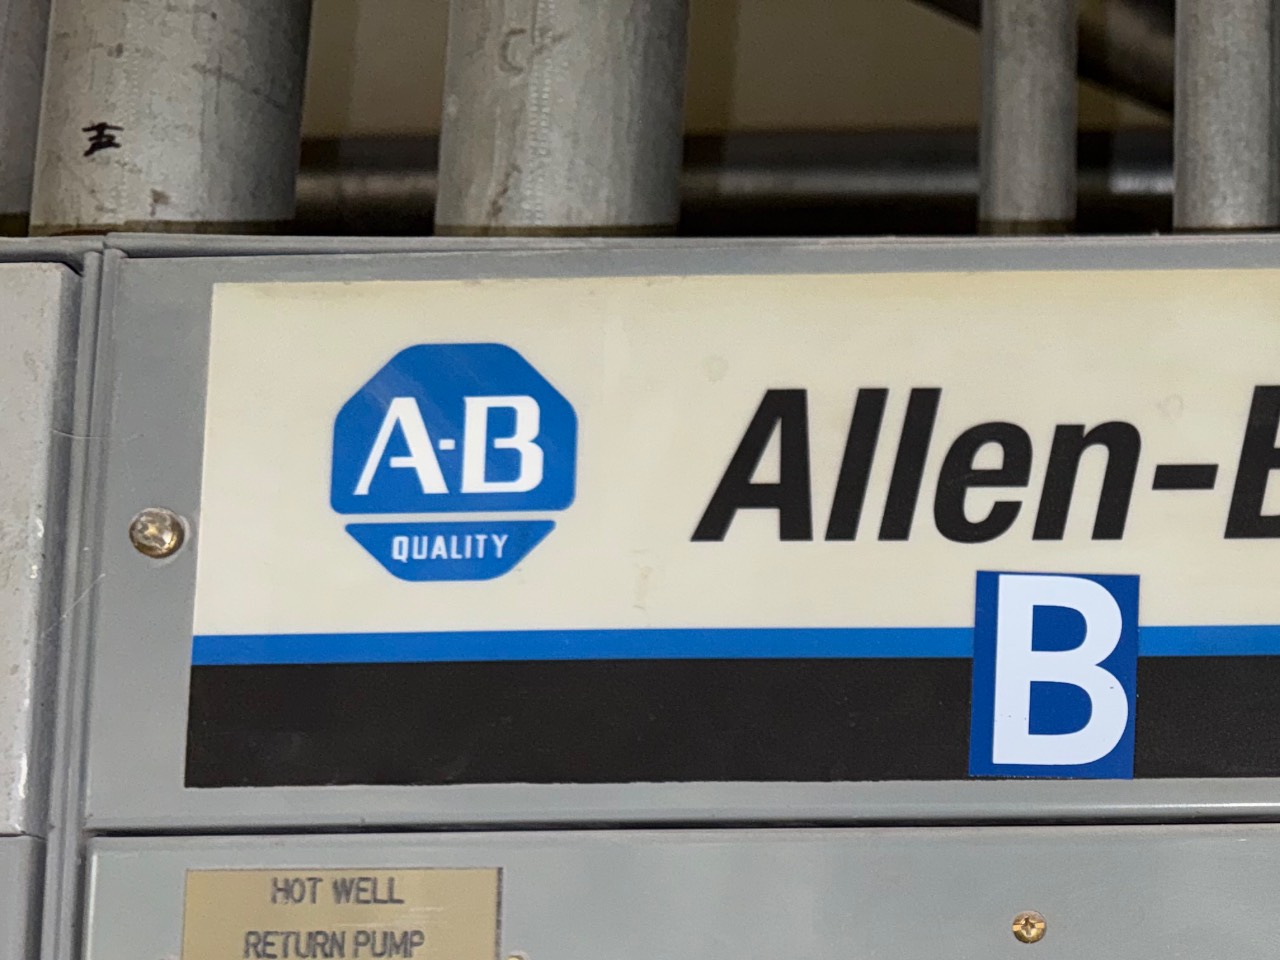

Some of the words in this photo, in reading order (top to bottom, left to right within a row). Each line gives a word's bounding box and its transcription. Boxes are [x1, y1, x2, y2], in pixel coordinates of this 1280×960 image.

[353, 395, 544, 496] A-B
[391, 534, 509, 563] QUALITY
[992, 573, 1131, 766] B
[271, 876, 323, 905] HOT
[332, 876, 405, 904] WELL
[243, 930, 347, 959] RETURN
[353, 929, 426, 958] PUMP
